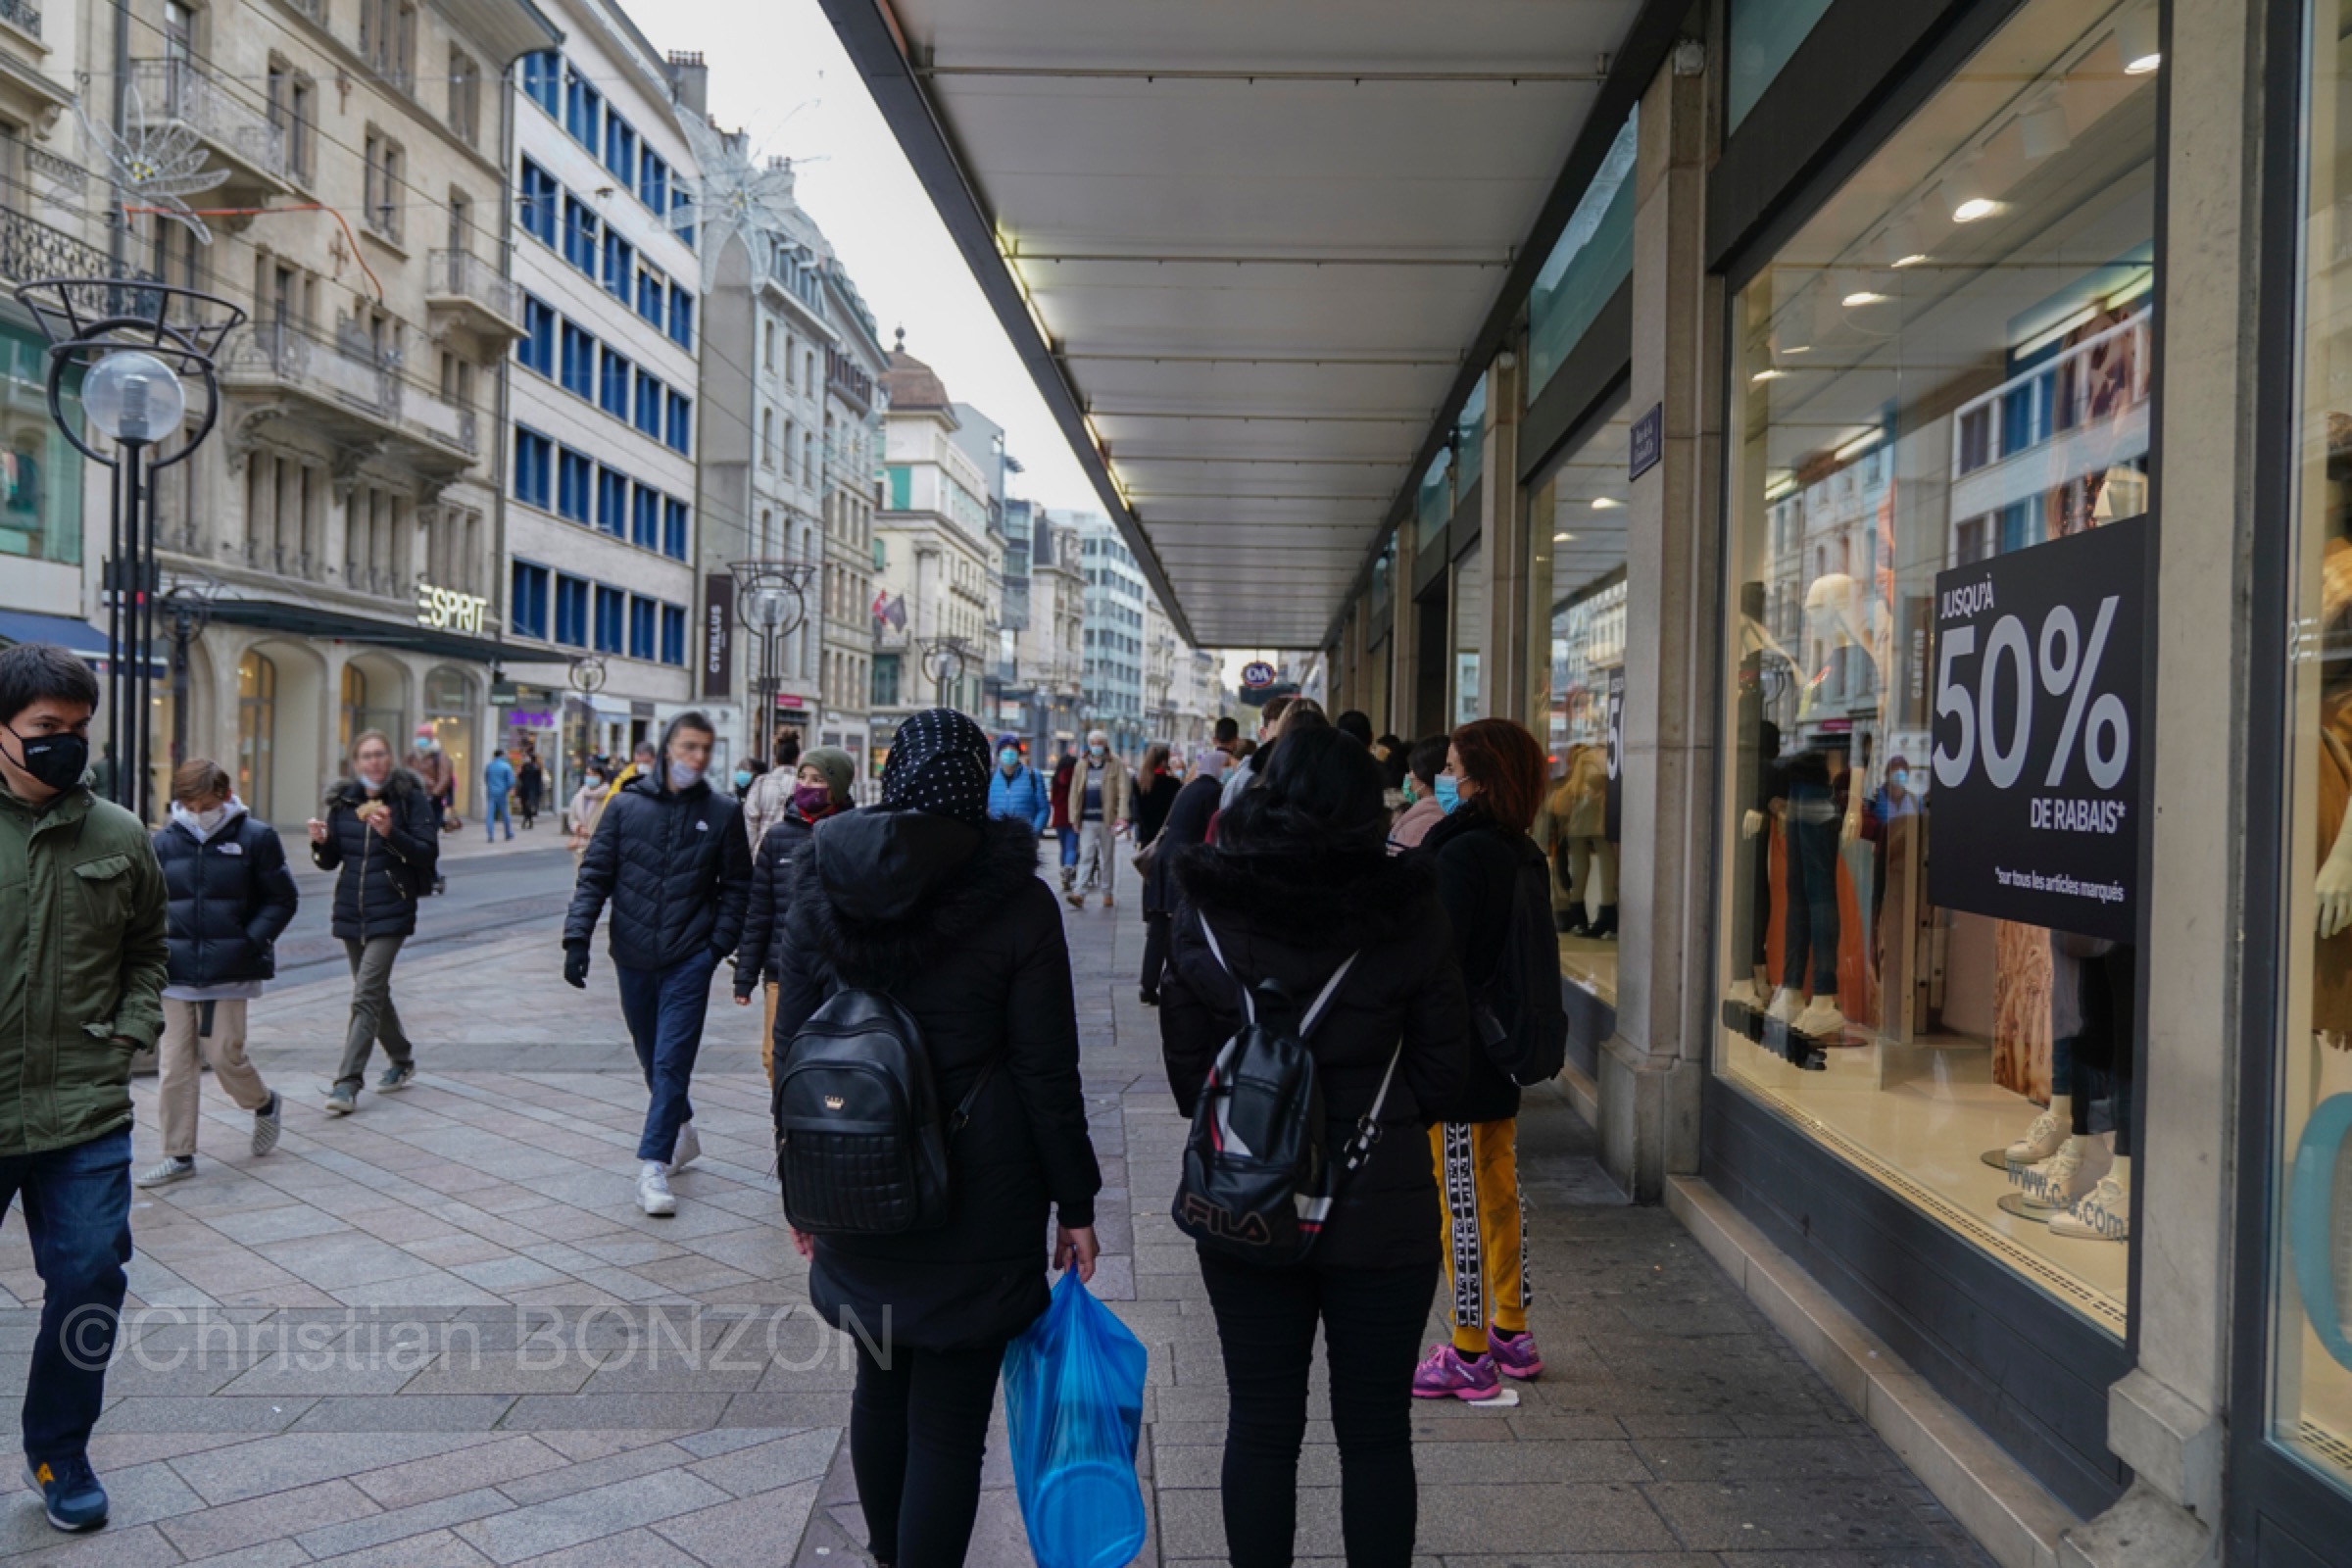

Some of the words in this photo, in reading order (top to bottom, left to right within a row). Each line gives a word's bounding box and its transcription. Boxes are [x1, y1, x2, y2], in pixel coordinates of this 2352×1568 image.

[417, 583, 487, 635] ESPRIT
[1940, 572, 1993, 619] JUSQU'À
[1933, 595, 2130, 790] 50%
[2031, 798, 2052, 829] DE
[2012, 870, 2032, 889] tous
[2032, 869, 2045, 890] les
[2045, 873, 2079, 896] articles
[2080, 880, 2125, 905] marqués
[1185, 1192, 1271, 1246] FILA
